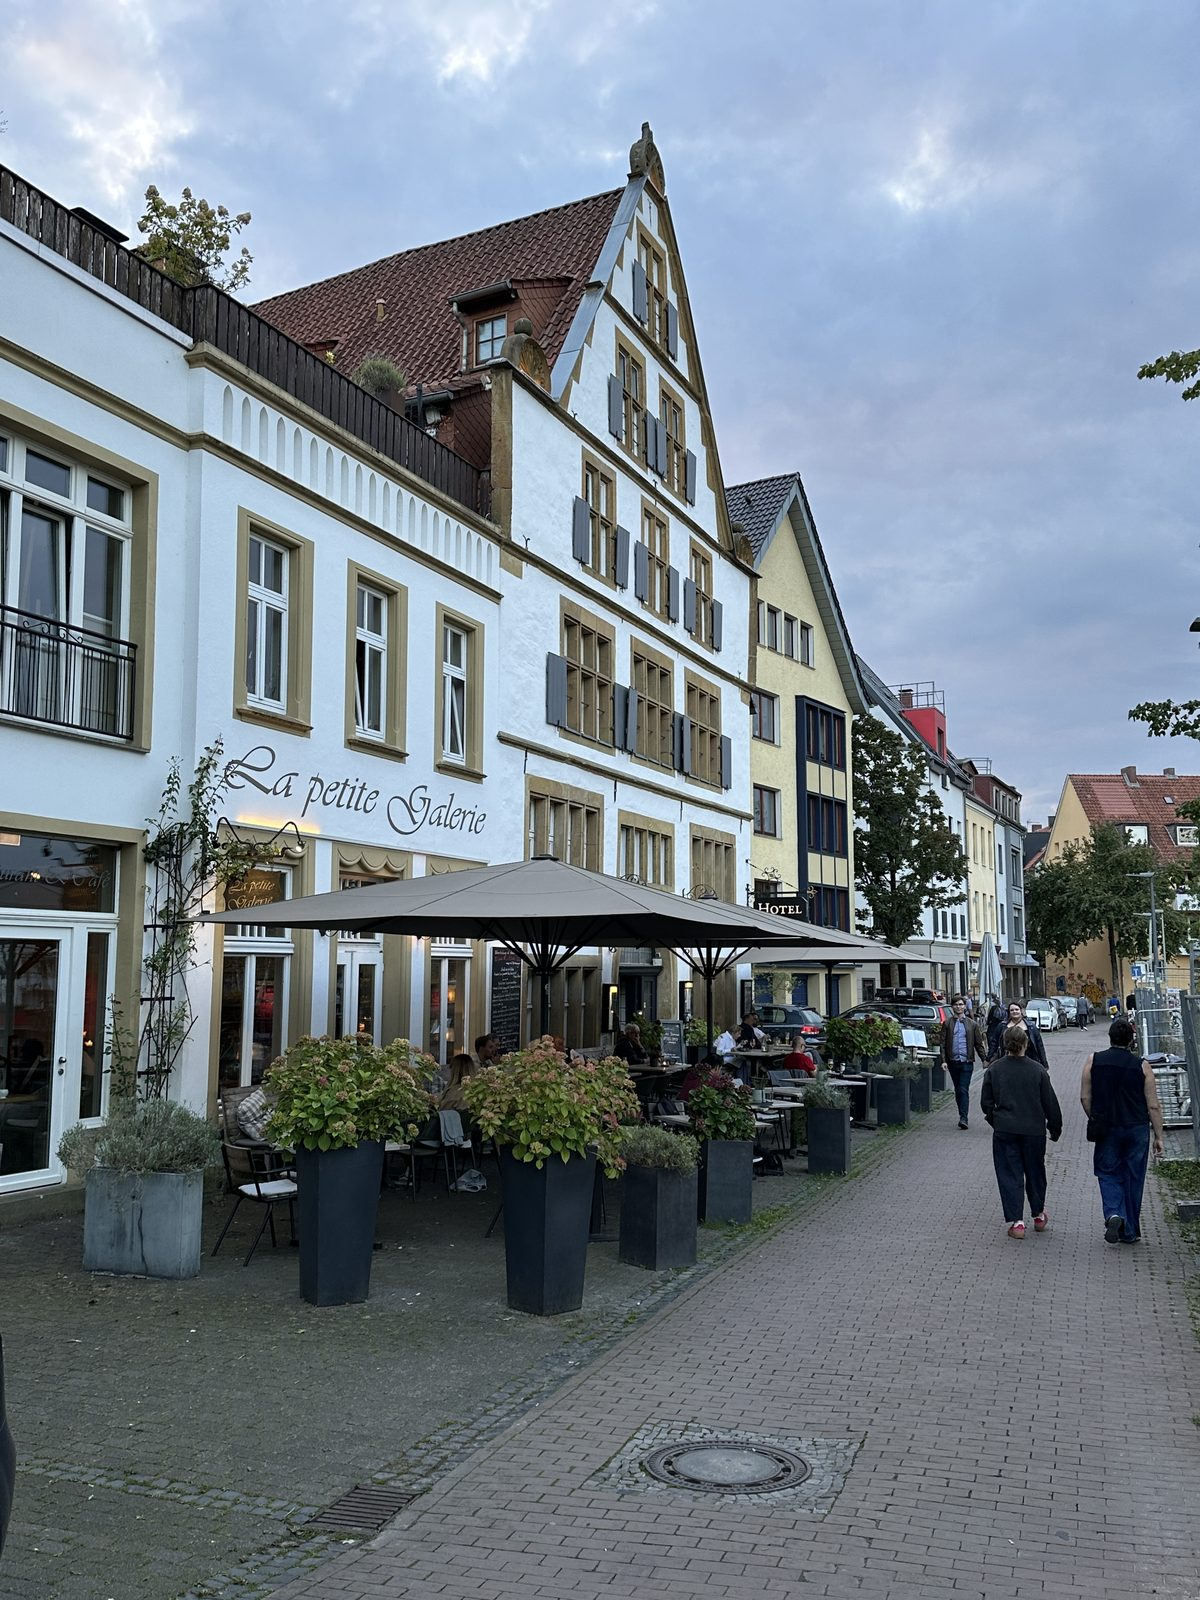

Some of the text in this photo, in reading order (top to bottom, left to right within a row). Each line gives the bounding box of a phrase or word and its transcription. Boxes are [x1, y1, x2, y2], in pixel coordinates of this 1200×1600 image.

[224, 745, 487, 835] La petite Galerie
[228, 880, 275, 894] La petite
[758, 902, 802, 915] HOTEL
